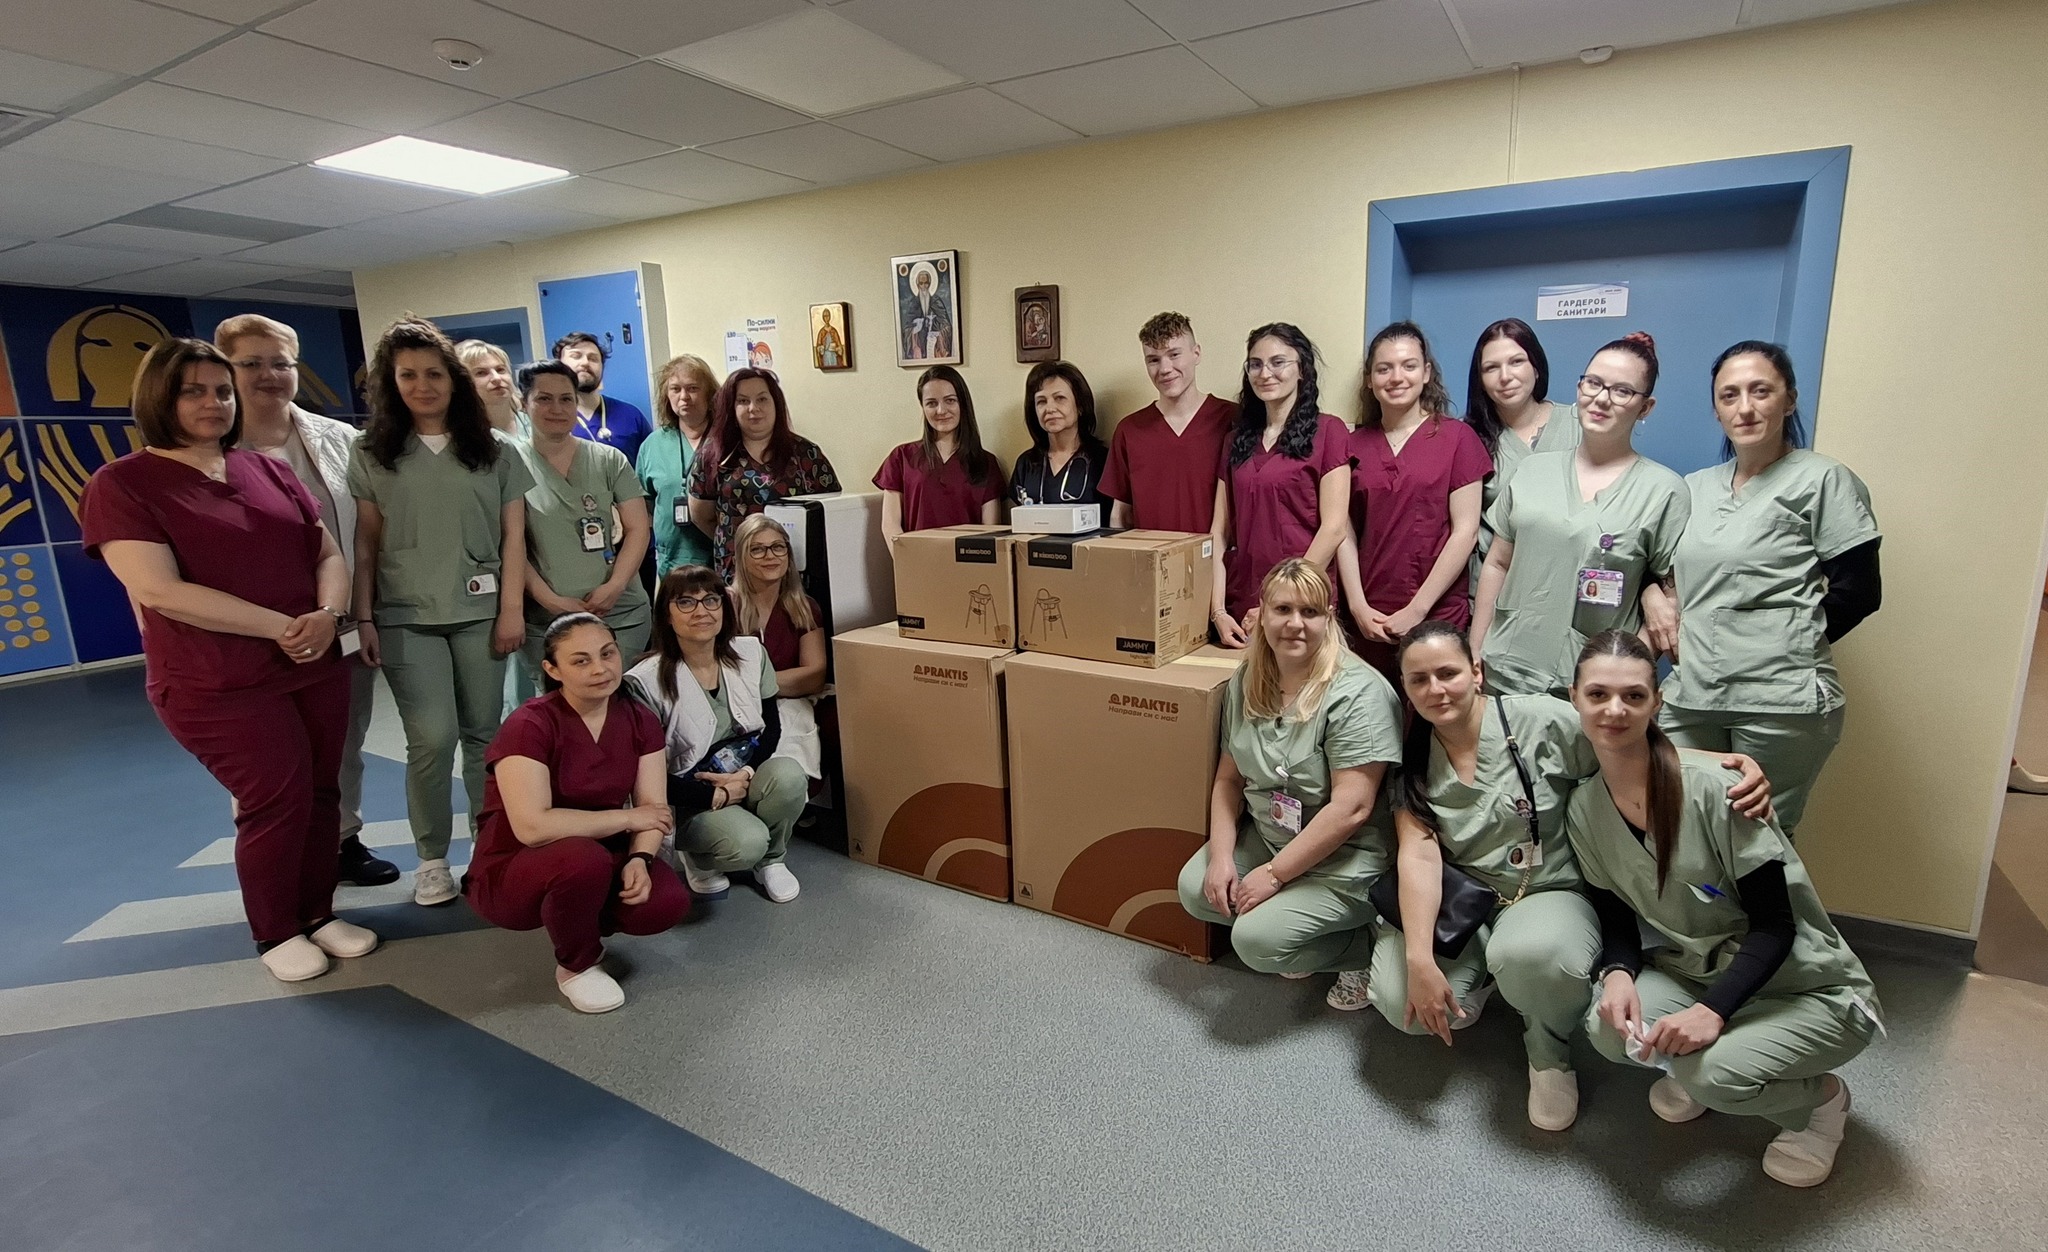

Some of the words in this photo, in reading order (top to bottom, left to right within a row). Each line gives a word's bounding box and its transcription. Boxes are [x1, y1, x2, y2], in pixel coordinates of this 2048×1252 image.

[1558, 298, 1607, 307] ГАРДЕРОБ
[1557, 307, 1606, 316] САНИТАРИ
[1122, 640, 1149, 651] JAMMY
[923, 665, 969, 681] PRAKTIS
[1122, 695, 1179, 714] PRAKTIS
[1108, 705, 1142, 717] Направи
[1160, 715, 1179, 723] нас!
